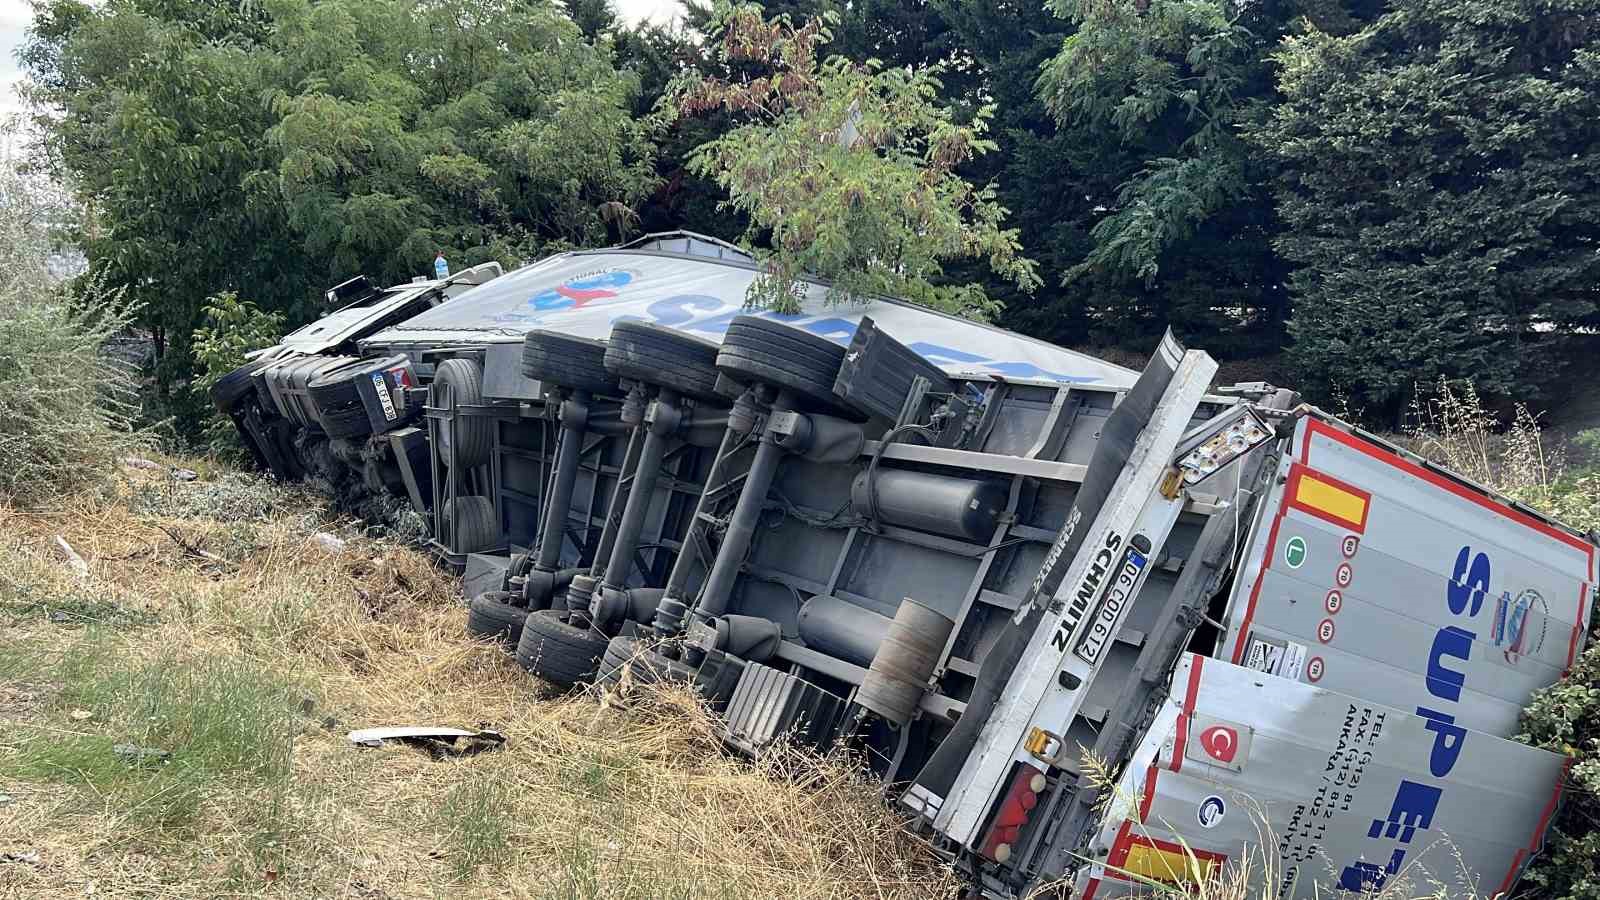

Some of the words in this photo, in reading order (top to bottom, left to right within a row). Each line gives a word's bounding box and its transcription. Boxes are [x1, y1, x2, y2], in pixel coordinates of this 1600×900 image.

[1288, 545, 1303, 558] L
[1051, 530, 1122, 652] SCHMITZ
[1121, 563, 1137, 587] 06
[1340, 570, 1349, 581] 70
[1102, 588, 1125, 622] COD
[1082, 623, 1107, 657] 612
[1325, 704, 1357, 771] ANKARA
[1354, 708, 1372, 744] FAX:
[1368, 712, 1386, 747] TEL:
